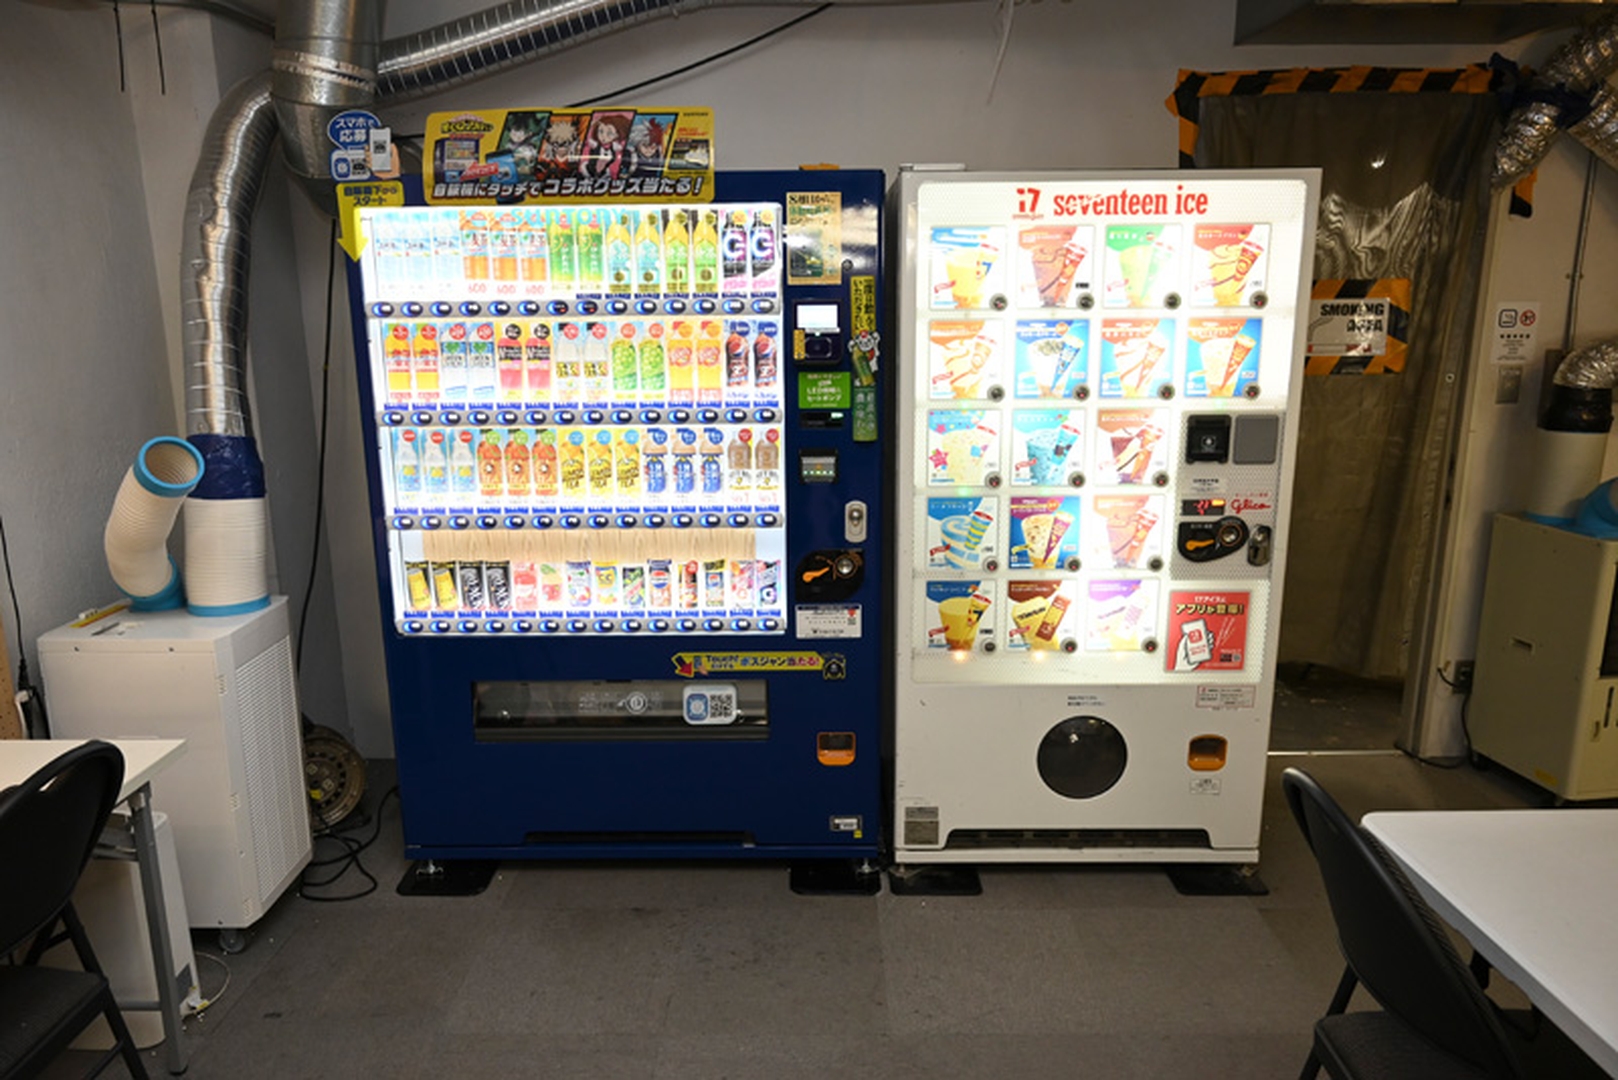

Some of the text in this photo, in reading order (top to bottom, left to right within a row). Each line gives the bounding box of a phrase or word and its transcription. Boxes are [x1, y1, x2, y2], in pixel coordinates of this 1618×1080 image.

[1053, 184, 1208, 216] seventeen ice
[510, 207, 625, 226] SUNTORY
[1320, 302, 1385, 317] SMOKNG
[1231, 498, 1271, 514] Glico
